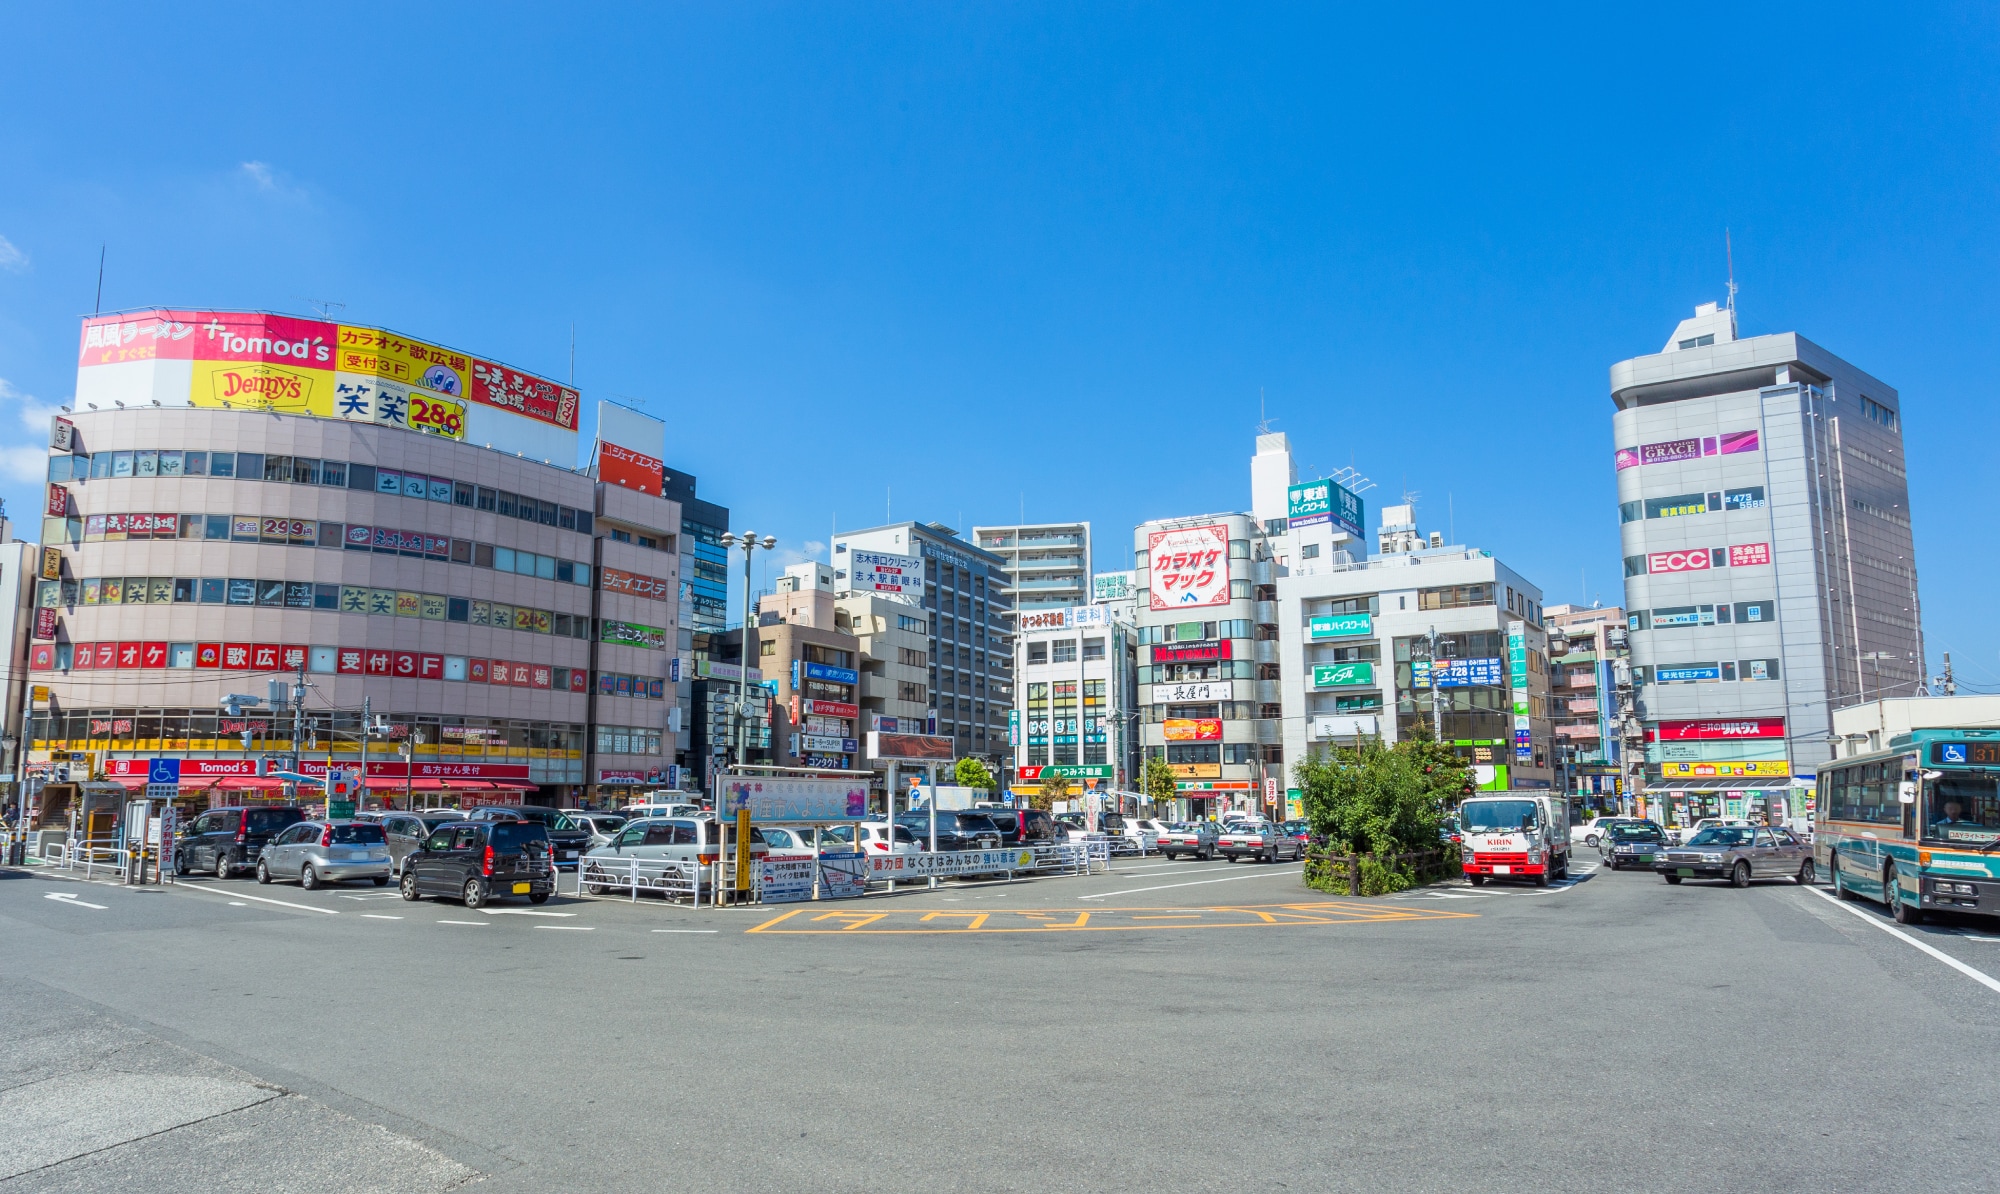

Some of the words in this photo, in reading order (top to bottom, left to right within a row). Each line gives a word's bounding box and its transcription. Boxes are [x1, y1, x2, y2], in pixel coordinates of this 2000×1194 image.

[81, 321, 193, 359] 風風ラーメン
[220, 331, 330, 362] Tomod's
[118, 346, 156, 360] すぐそこ
[342, 331, 407, 353] カラオケ
[409, 344, 466, 372] 歌広場
[346, 354, 407, 375] 受付3F
[223, 372, 302, 399] Denny's
[474, 365, 538, 398] うまいもん
[336, 383, 407, 424] 笑笑
[488, 385, 525, 412] 酒場
[612, 447, 662, 471] ジェイエステ
[1645, 444, 1697, 459] GRACE
[1303, 485, 1328, 502] 東進
[1733, 494, 1752, 503] 473
[1290, 500, 1328, 515] ハイスクール
[1739, 500, 1765, 509] 5588
[235, 521, 257, 532] 全品
[263, 519, 313, 536] 299円
[1732, 545, 1765, 555] 英会話
[856, 553, 920, 568] 志木南口クリニック
[1154, 549, 1222, 571] カラオケ
[1651, 551, 1707, 572] ECC
[603, 572, 666, 595] ジェイエステ
[855, 571, 921, 587] 志木駅前眼科
[1162, 570, 1215, 591] マック
[128, 584, 171, 602] 笑笑
[344, 589, 393, 613] 笑笑
[426, 608, 441, 616] 4F
[472, 606, 508, 626] 笑笑
[1021, 612, 1064, 629] かつみ不動産
[1076, 606, 1102, 623] 歯科
[1312, 619, 1369, 632] 東進ハイスクール
[617, 627, 643, 642] こころ
[78, 646, 164, 665] カラオケ
[227, 647, 305, 668] 歌広場
[341, 651, 440, 675] 受付3F
[1154, 647, 1175, 662] Ms
[1176, 648, 1219, 660] WOMAN
[493, 665, 549, 686] 歌広場
[1317, 666, 1356, 684] エイブル
[1450, 667, 1468, 676] 728
[1662, 670, 1714, 680] 栄光ゼミナール
[1173, 685, 1210, 700] 長屋門
[1029, 719, 1095, 735] けやき歯科
[1700, 722, 1761, 735] 三井のリハウス
[808, 757, 838, 769] コンタクト
[1976, 748, 1996, 761] 31
[199, 762, 249, 773] Tomod's
[422, 765, 481, 775] 処方せん受付
[1025, 768, 1035, 777] 2F
[1053, 767, 1103, 776] かつみ不動産
[1268, 780, 1276, 801] カラオケ
[744, 796, 850, 819] 新座市へようこそ
[163, 808, 173, 863] バイク利用不可
[873, 857, 904, 871] 暴力団
[907, 853, 981, 868] なくすはみんなの
[983, 852, 1017, 864] 強い意志
[775, 872, 810, 880] バイク駐車場
